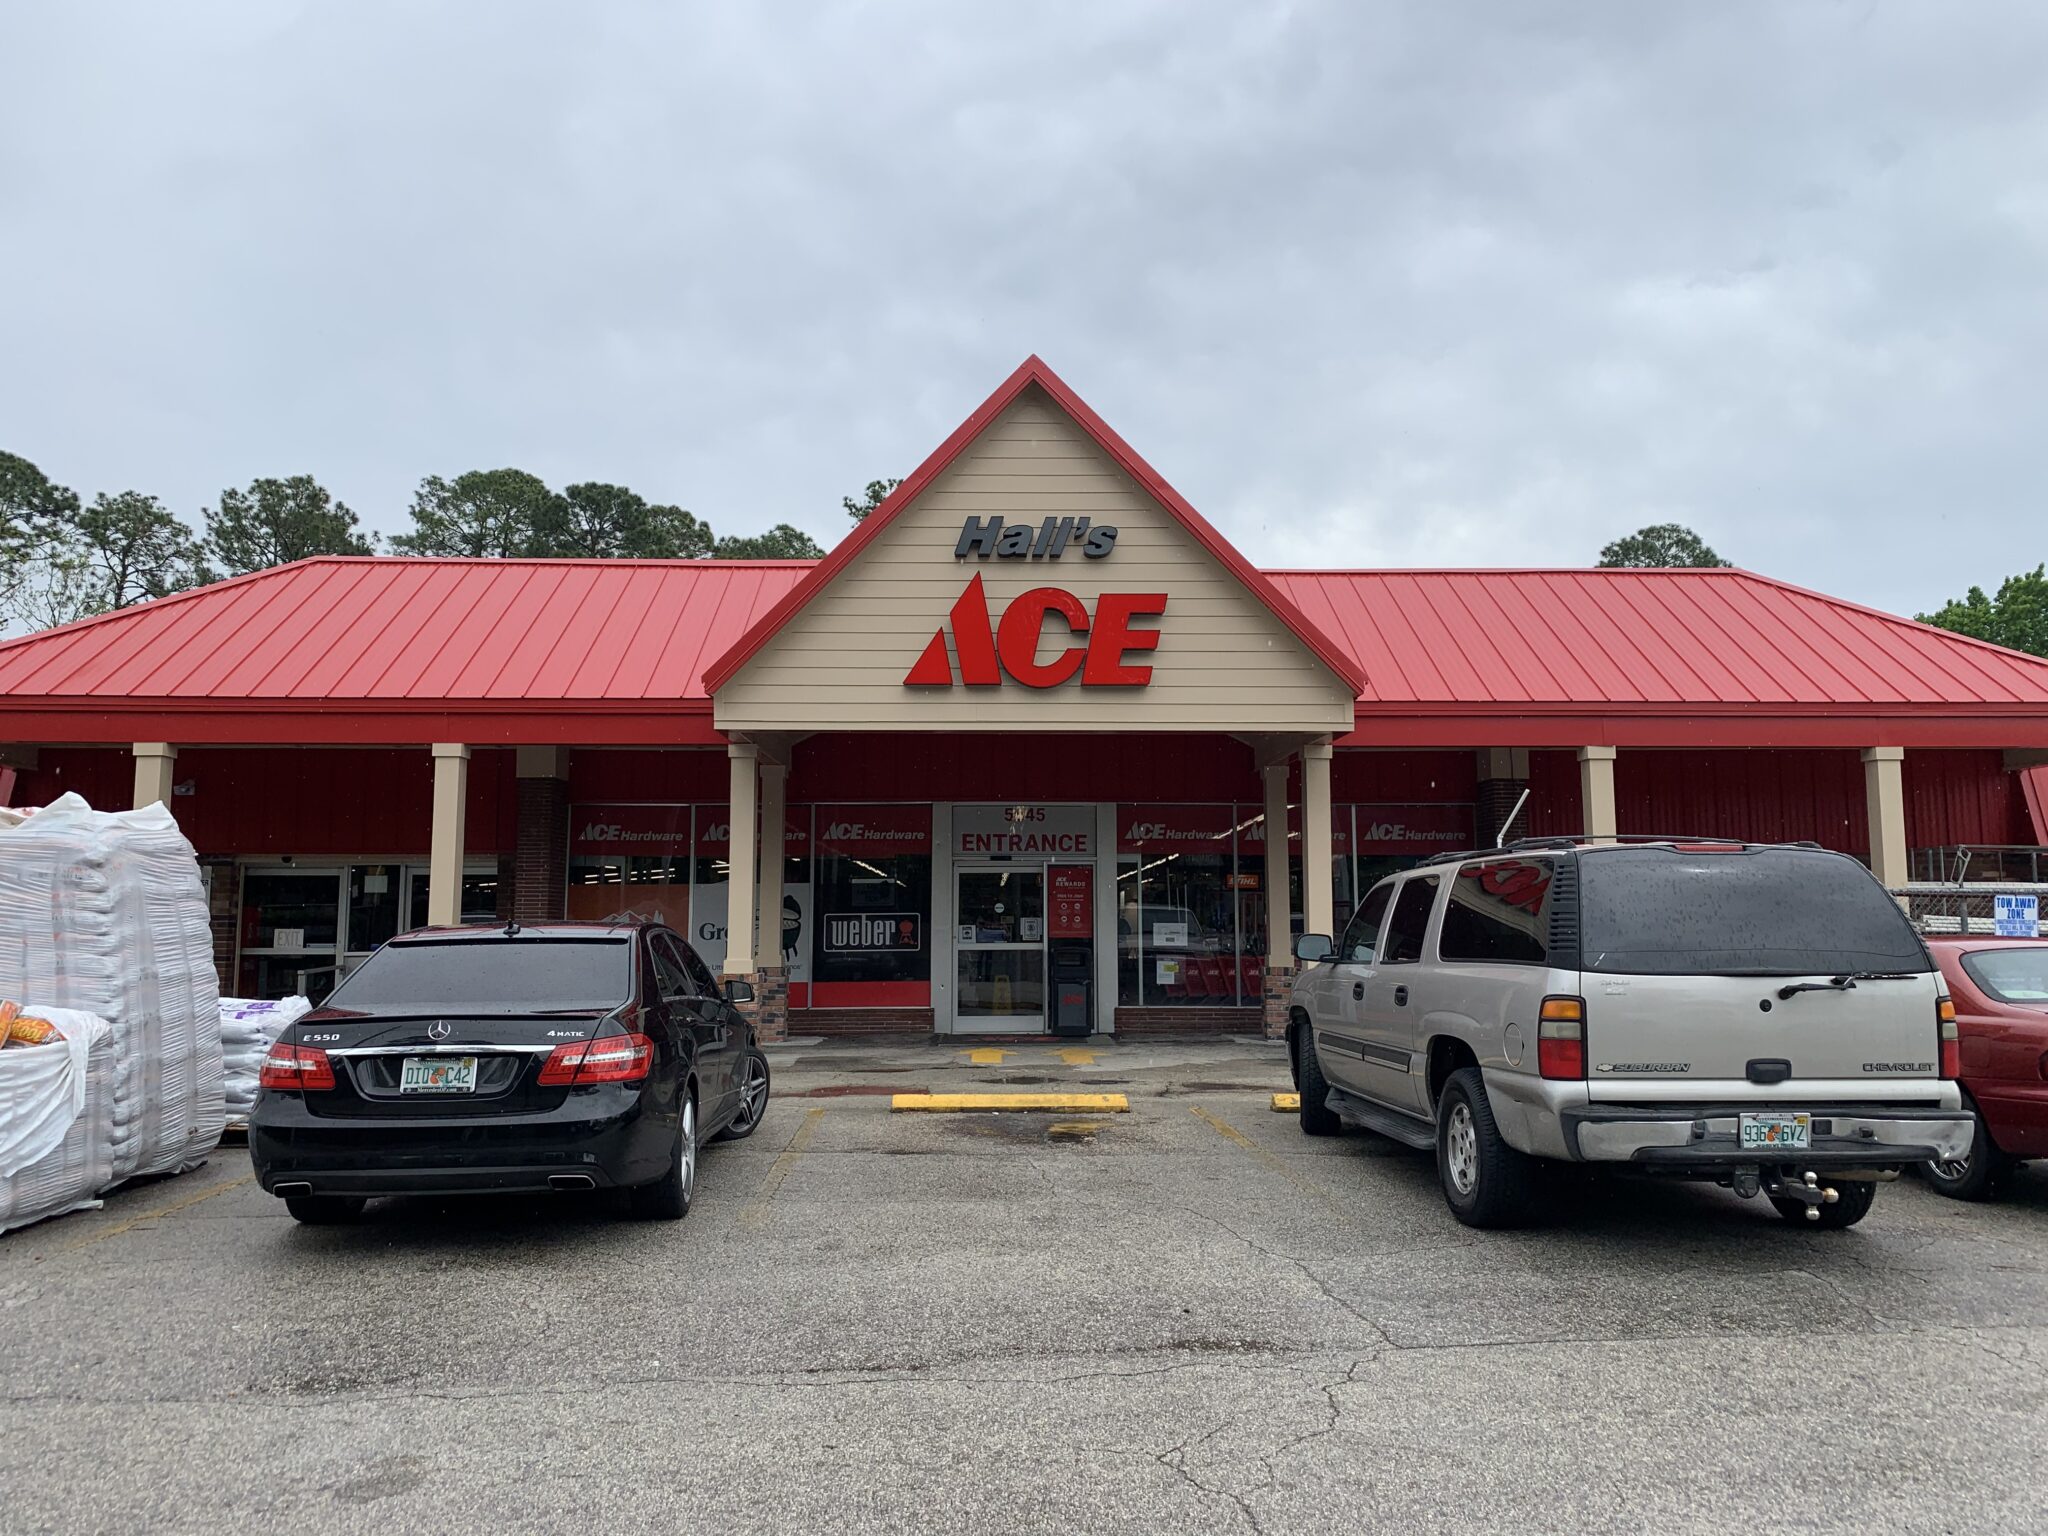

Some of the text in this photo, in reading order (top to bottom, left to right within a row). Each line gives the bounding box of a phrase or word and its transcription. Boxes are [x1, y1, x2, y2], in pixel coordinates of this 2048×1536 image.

[954, 515, 1119, 559] Hall's
[902, 570, 1169, 689] ACE
[578, 822, 684, 841] ACE Hardware
[822, 821, 864, 840] ACE
[863, 830, 926, 840] Hardware
[1125, 821, 1166, 840] ACE
[1363, 821, 1406, 841] ACE
[1405, 830, 1467, 841] Hardware
[961, 833, 1088, 852] ENTRANCE
[1996, 897, 2036, 909] TOW AWAY
[2007, 908, 2025, 920] ZONE
[277, 930, 301, 946] EXIT
[831, 914, 896, 946] weber
[445, 1066, 471, 1084] C42
[1613, 1063, 1691, 1072] SUBURBAN
[1862, 1063, 1935, 1072] CHEVROLET
[1744, 1124, 1805, 1142] 936 6VZ
